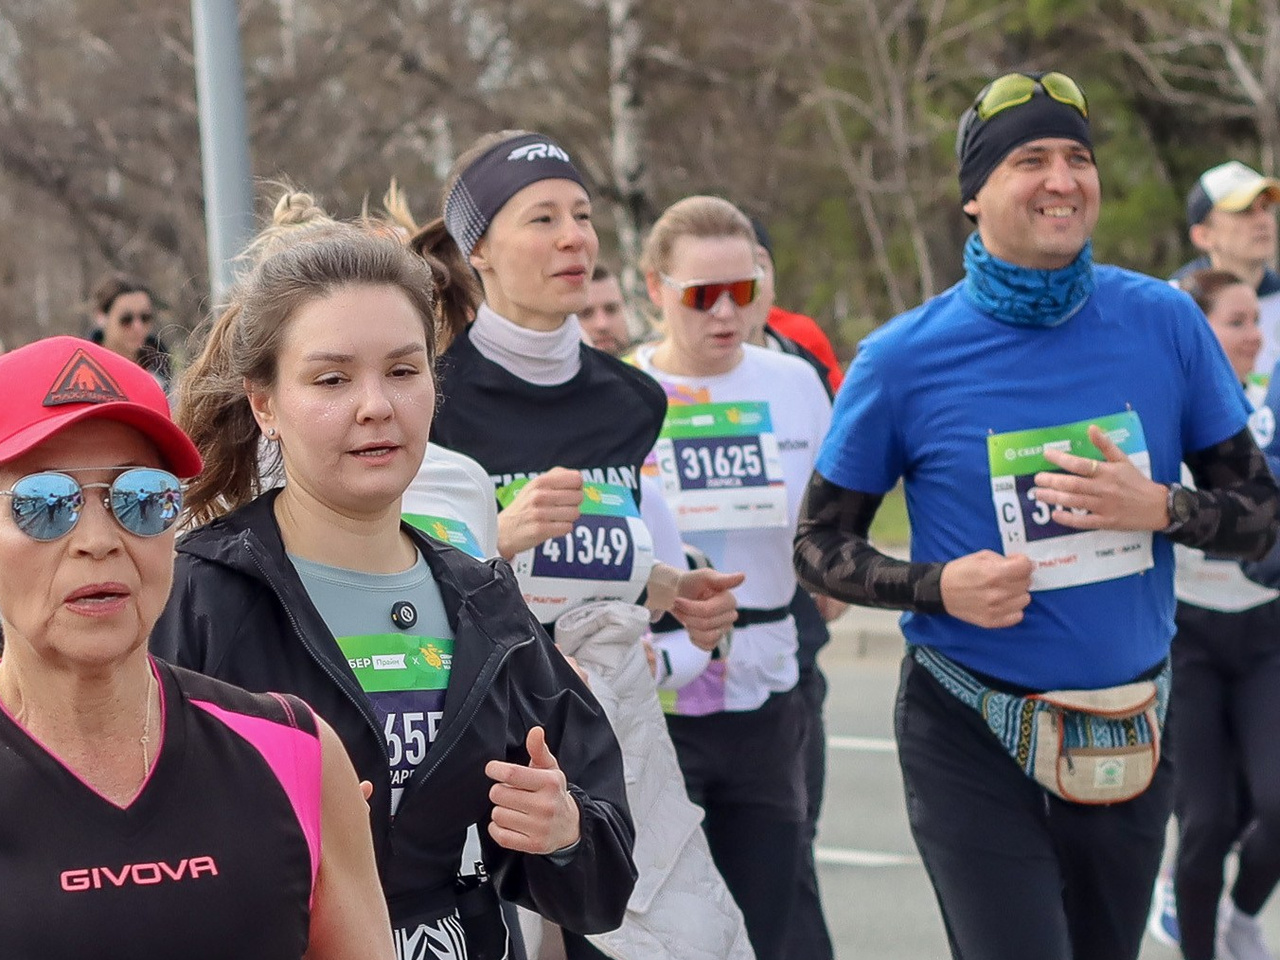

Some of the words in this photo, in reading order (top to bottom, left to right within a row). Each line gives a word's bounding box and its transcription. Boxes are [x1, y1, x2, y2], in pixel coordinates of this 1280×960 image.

[681, 444, 763, 479] 31625
[1002, 502, 1016, 524] C
[543, 526, 628, 566] 41349
[349, 658, 371, 669] БЕР
[60, 856, 219, 892] GIVOVA
